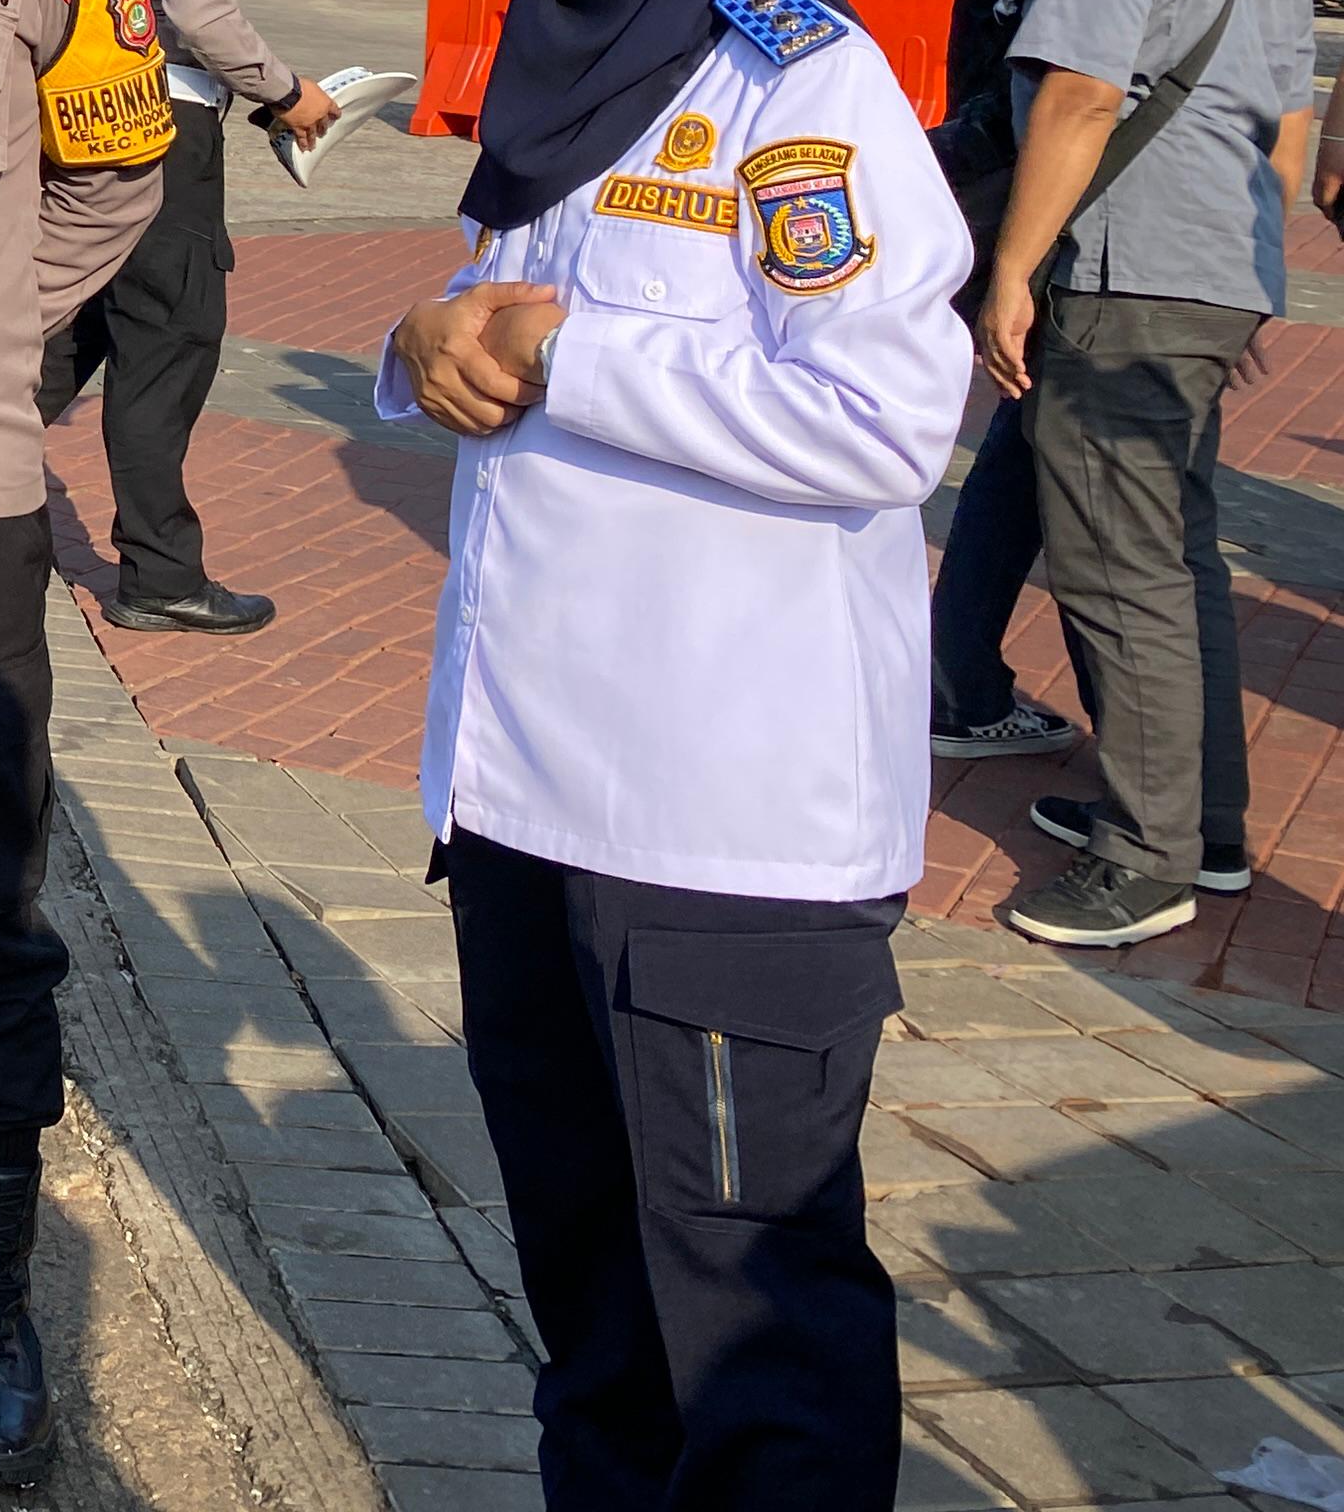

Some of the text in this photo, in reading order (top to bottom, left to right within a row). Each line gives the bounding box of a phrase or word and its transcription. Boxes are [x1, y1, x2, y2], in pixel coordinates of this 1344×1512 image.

[68, 128, 106, 143] KEL.
[87, 136, 137, 155] KEC.
[746, 147, 844, 178] TANGERANG SELATAN
